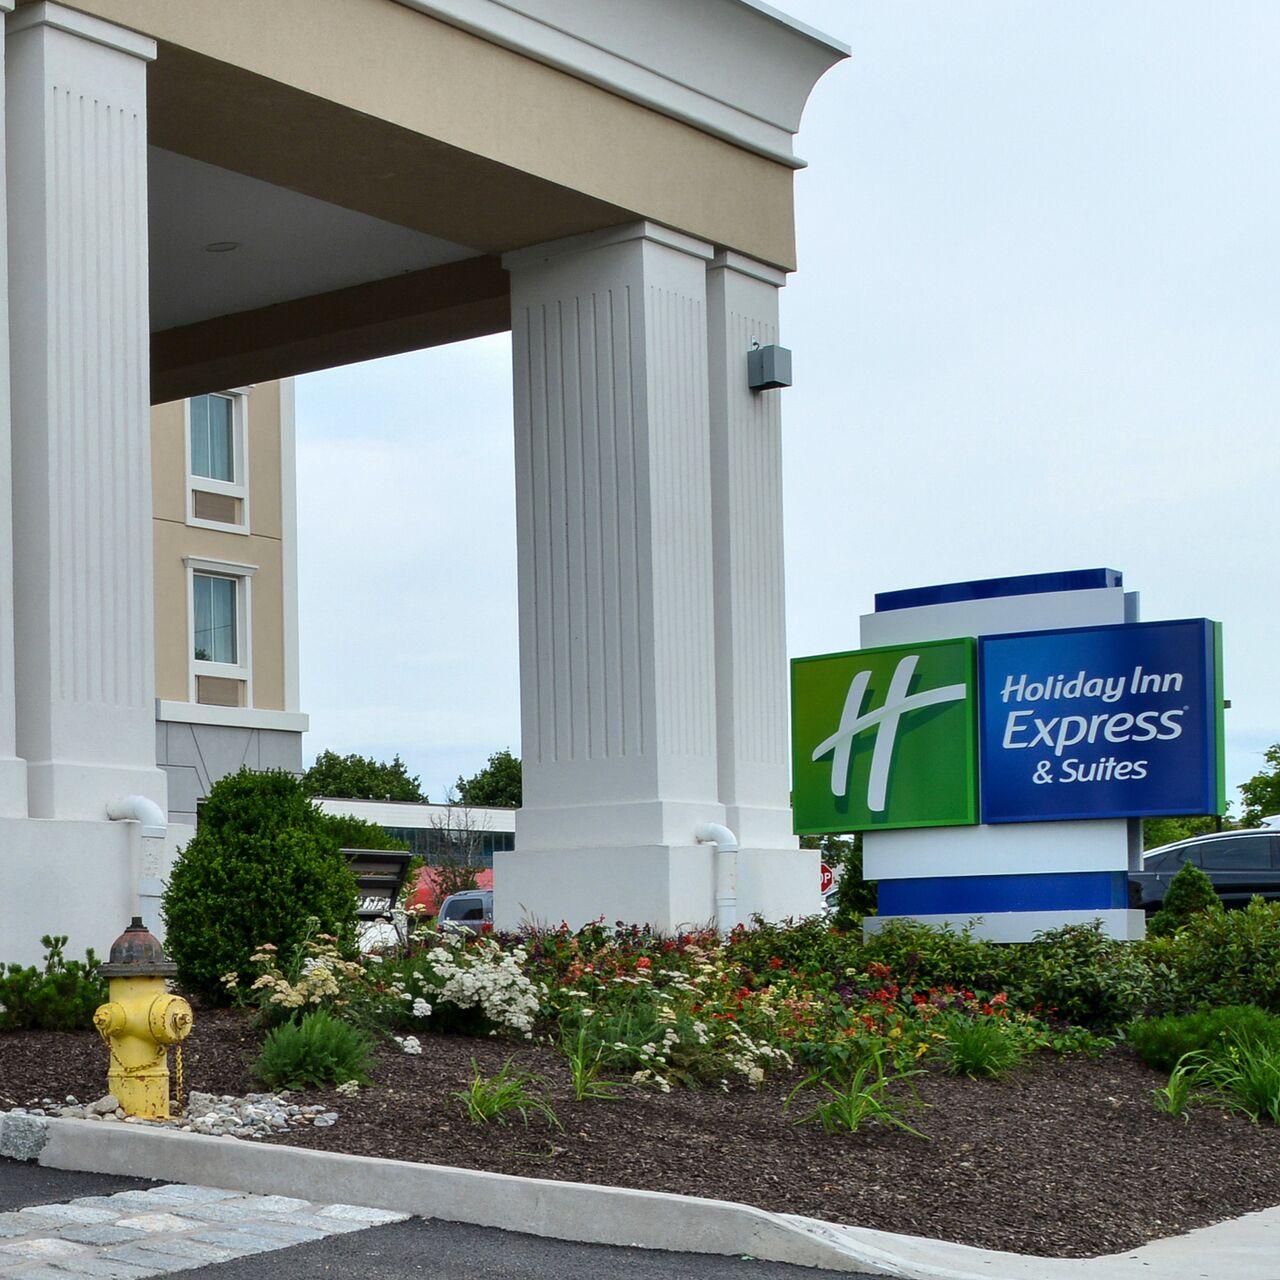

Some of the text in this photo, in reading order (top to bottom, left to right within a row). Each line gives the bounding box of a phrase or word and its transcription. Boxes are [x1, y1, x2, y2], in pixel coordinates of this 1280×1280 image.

[1000, 666, 1183, 703] Holiday Inn
[1002, 709, 1184, 757] Express
[1032, 757, 1148, 784] & Suites
